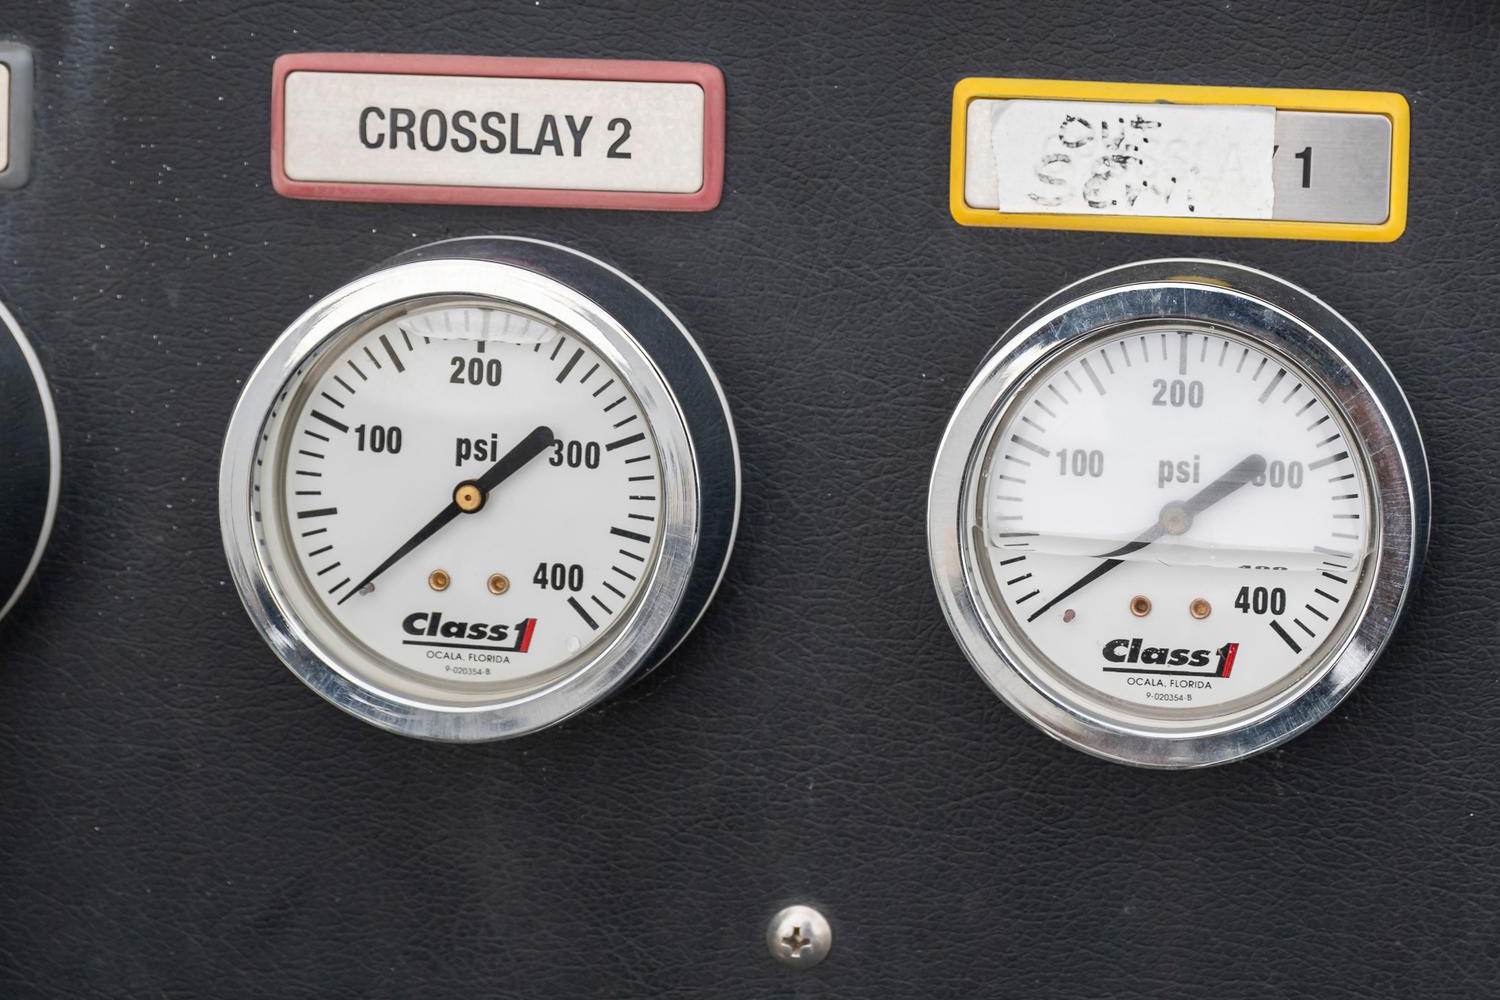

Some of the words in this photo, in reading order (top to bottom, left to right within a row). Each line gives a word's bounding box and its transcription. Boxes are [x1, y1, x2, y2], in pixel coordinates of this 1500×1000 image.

[358, 106, 593, 158] CROSSLAY
[606, 117, 632, 160] 2
[1295, 146, 1312, 189] 1
[449, 356, 503, 387] 200
[1151, 378, 1204, 408] 200
[354, 424, 402, 454] 100
[455, 433, 499, 467] psi
[548, 439, 600, 469] 300
[1056, 449, 1104, 477] 100
[1158, 455, 1200, 489] psi
[533, 563, 584, 592] 400
[1234, 586, 1287, 616] 400
[468, 653, 510, 664] FLORIDA
[1127, 677, 1166, 688] OCALA,
[1170, 679, 1212, 689] FLORIDA
